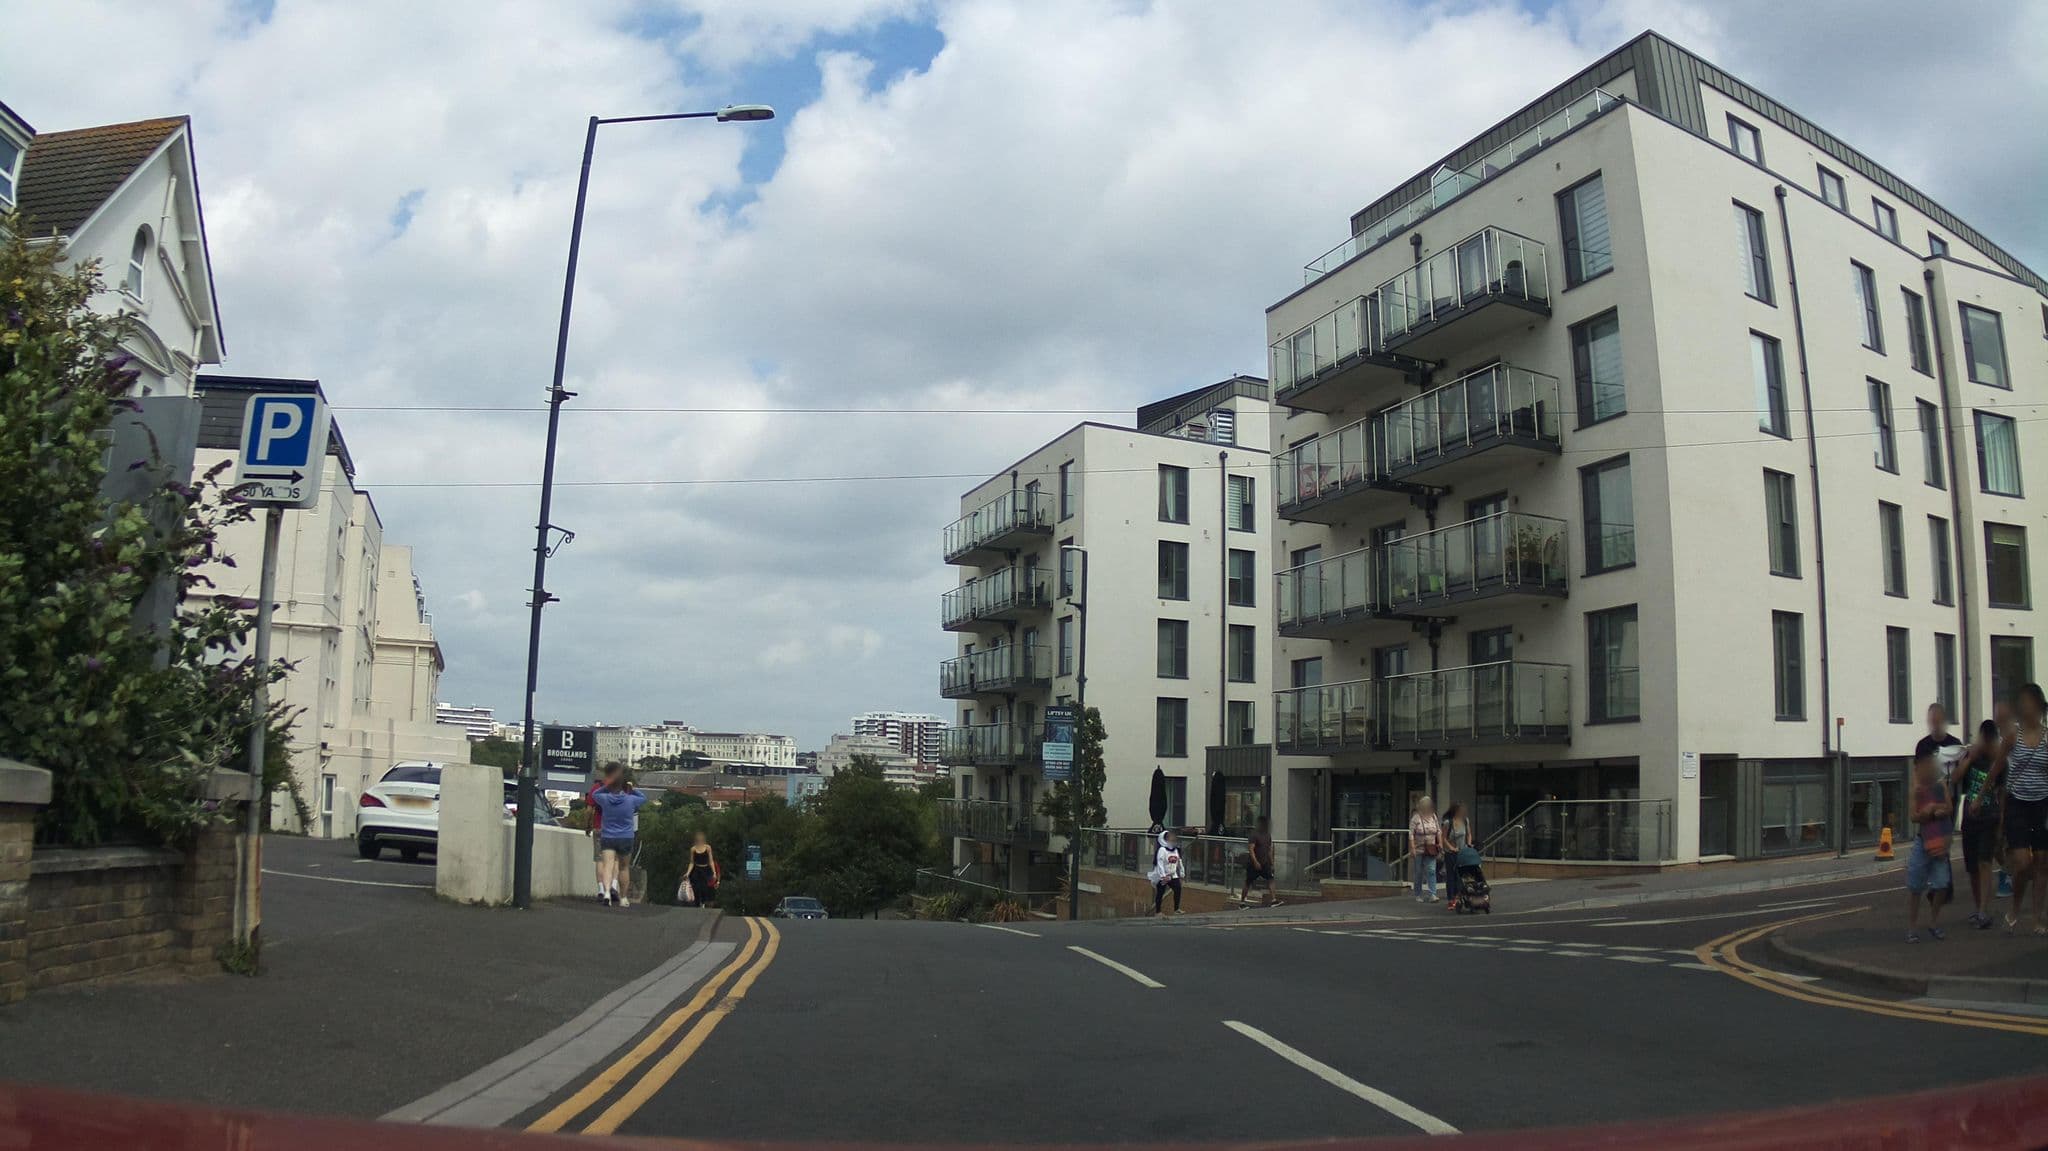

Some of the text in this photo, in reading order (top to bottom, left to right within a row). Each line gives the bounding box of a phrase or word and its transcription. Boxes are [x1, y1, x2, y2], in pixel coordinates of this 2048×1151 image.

[256, 402, 303, 461] P
[261, 486, 300, 499] YAS
[561, 730, 574, 749] B
[547, 749, 587, 759] BROOKLANDS
